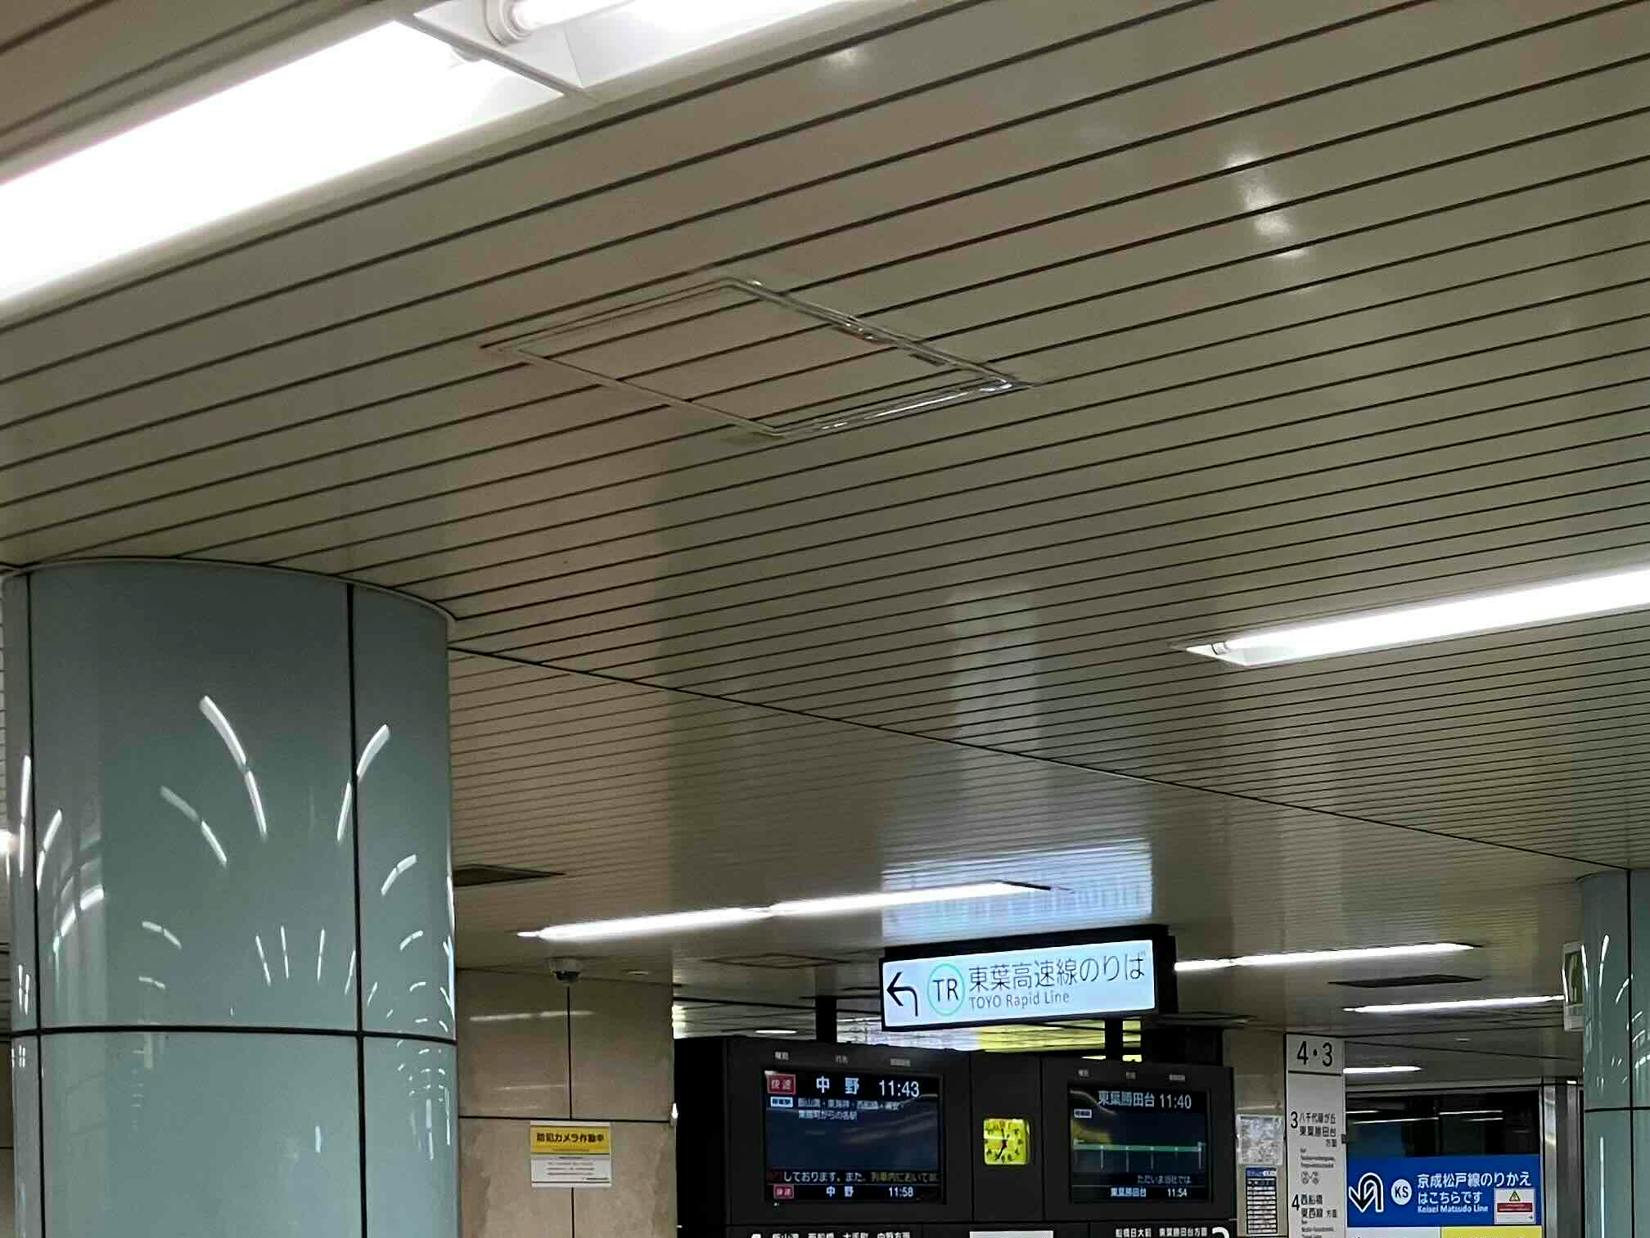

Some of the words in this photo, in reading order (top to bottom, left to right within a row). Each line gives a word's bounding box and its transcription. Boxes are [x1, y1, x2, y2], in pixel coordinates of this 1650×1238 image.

[968, 949, 1147, 993] 東葉高速線のりば
[933, 977, 960, 1002] TR
[968, 994, 1001, 1010] TOYO
[1006, 991, 1040, 1011] Rapid
[1043, 989, 1070, 1006] Line
[879, 1079, 920, 1098] 11:43
[1159, 1093, 1192, 1110] 11:40
[1290, 1110, 1299, 1129] 3
[1417, 1171, 1532, 1189] 京成松戸線のりかえ
[888, 1186, 914, 1198] 11:58
[1167, 1187, 1188, 1198] 11:54
[1394, 1185, 1409, 1198] KS
[1417, 1191, 1483, 1205] はこちらです
[1291, 1193, 1300, 1212] 4
[1440, 1204, 1473, 1214] Matsudo
[1473, 1204, 1489, 1213] Line
